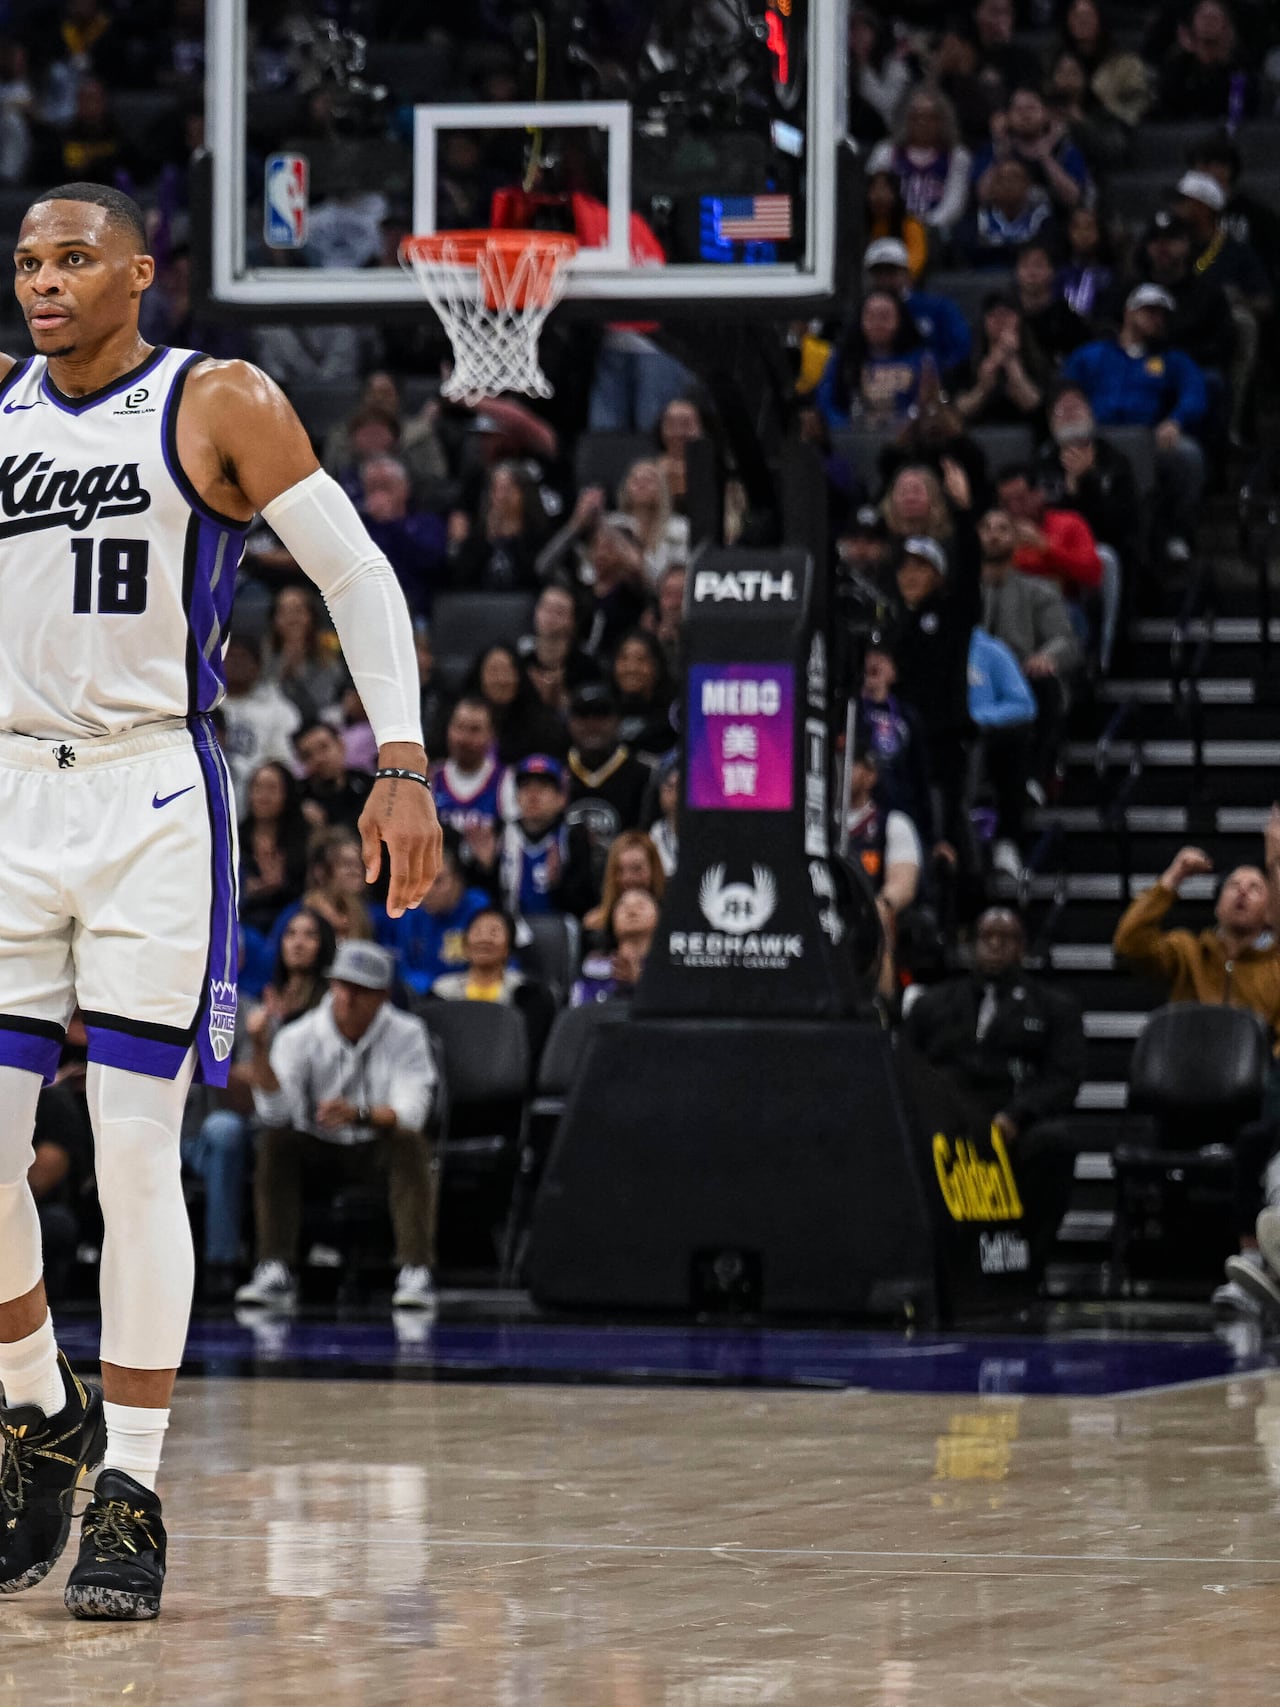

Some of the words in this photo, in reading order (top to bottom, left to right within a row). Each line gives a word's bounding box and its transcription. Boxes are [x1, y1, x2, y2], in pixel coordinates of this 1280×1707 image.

[70, 538, 149, 614] 18
[694, 570, 793, 602] PATH
[669, 931, 803, 957] REDHAWK
